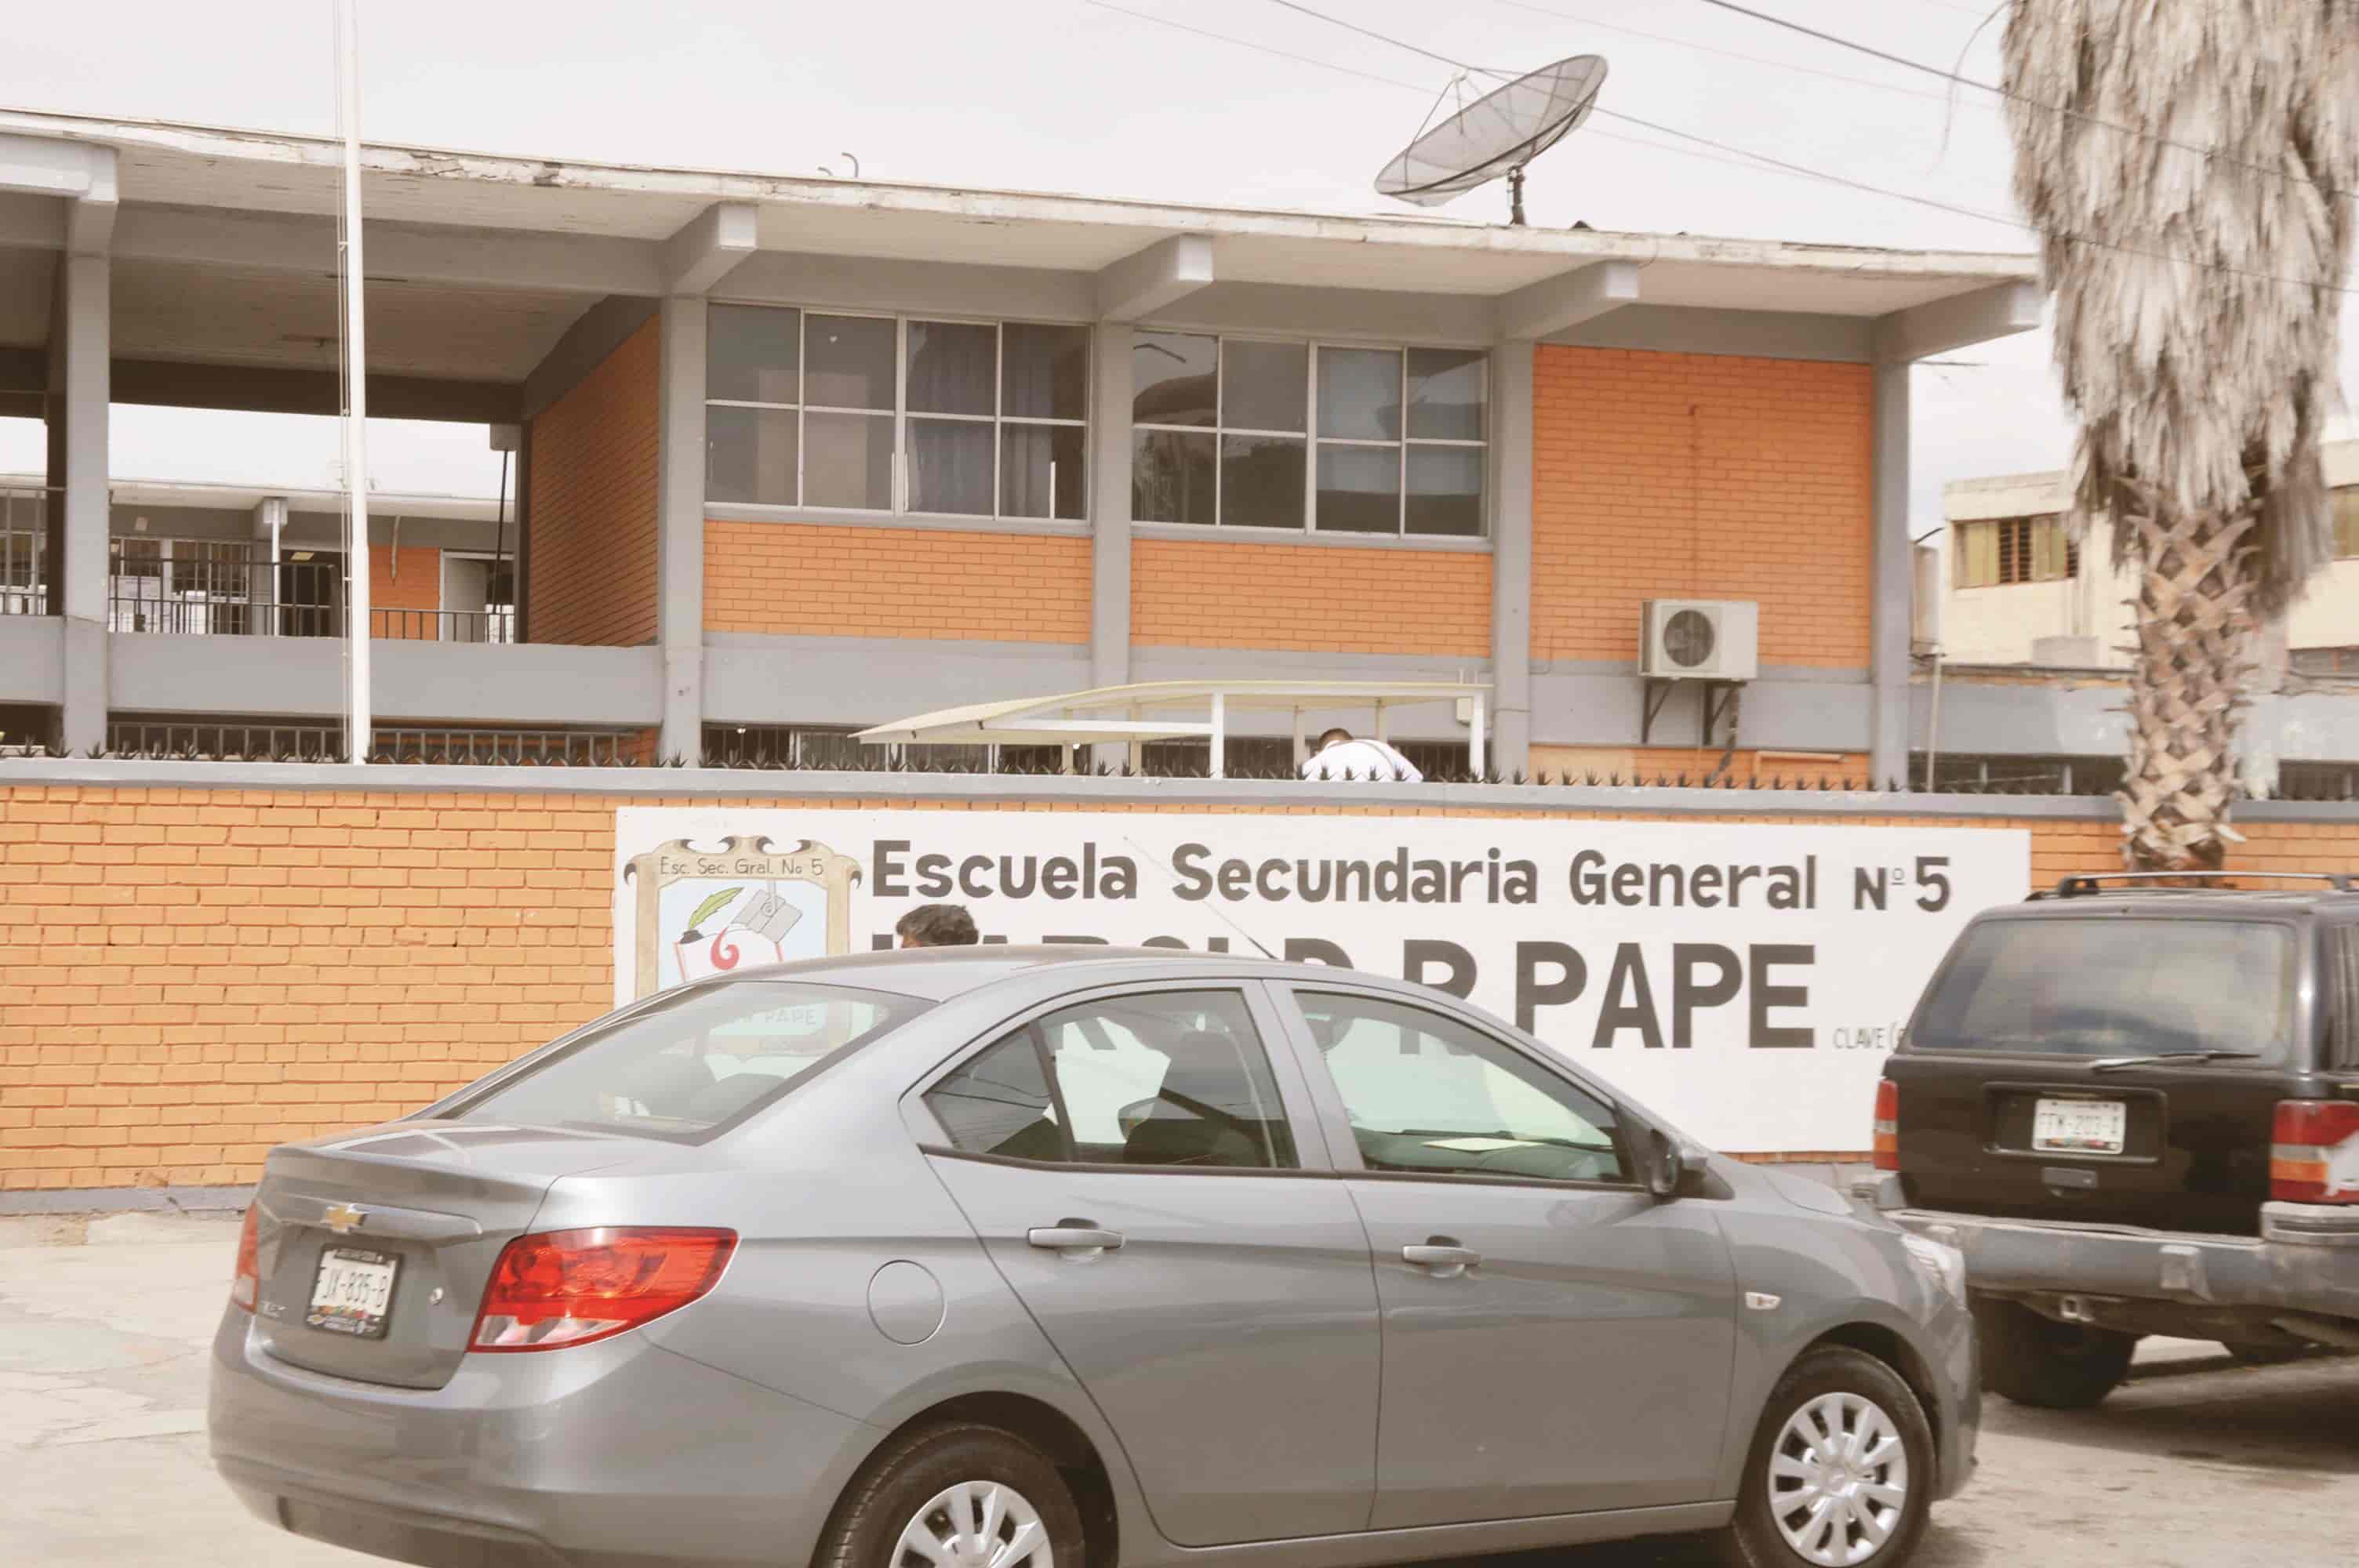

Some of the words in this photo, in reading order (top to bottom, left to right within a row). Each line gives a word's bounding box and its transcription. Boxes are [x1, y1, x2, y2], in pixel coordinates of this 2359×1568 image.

[660, 855, 690, 875] Esc.
[697, 857, 729, 875] Sec.
[811, 858, 823, 877] 5
[873, 840, 1136, 899] Escuela
[1172, 844, 1537, 904] Secundaria
[1570, 849, 1816, 910] General
[1916, 856, 1950, 913] 5
[1514, 941, 1816, 1049] PAPE
